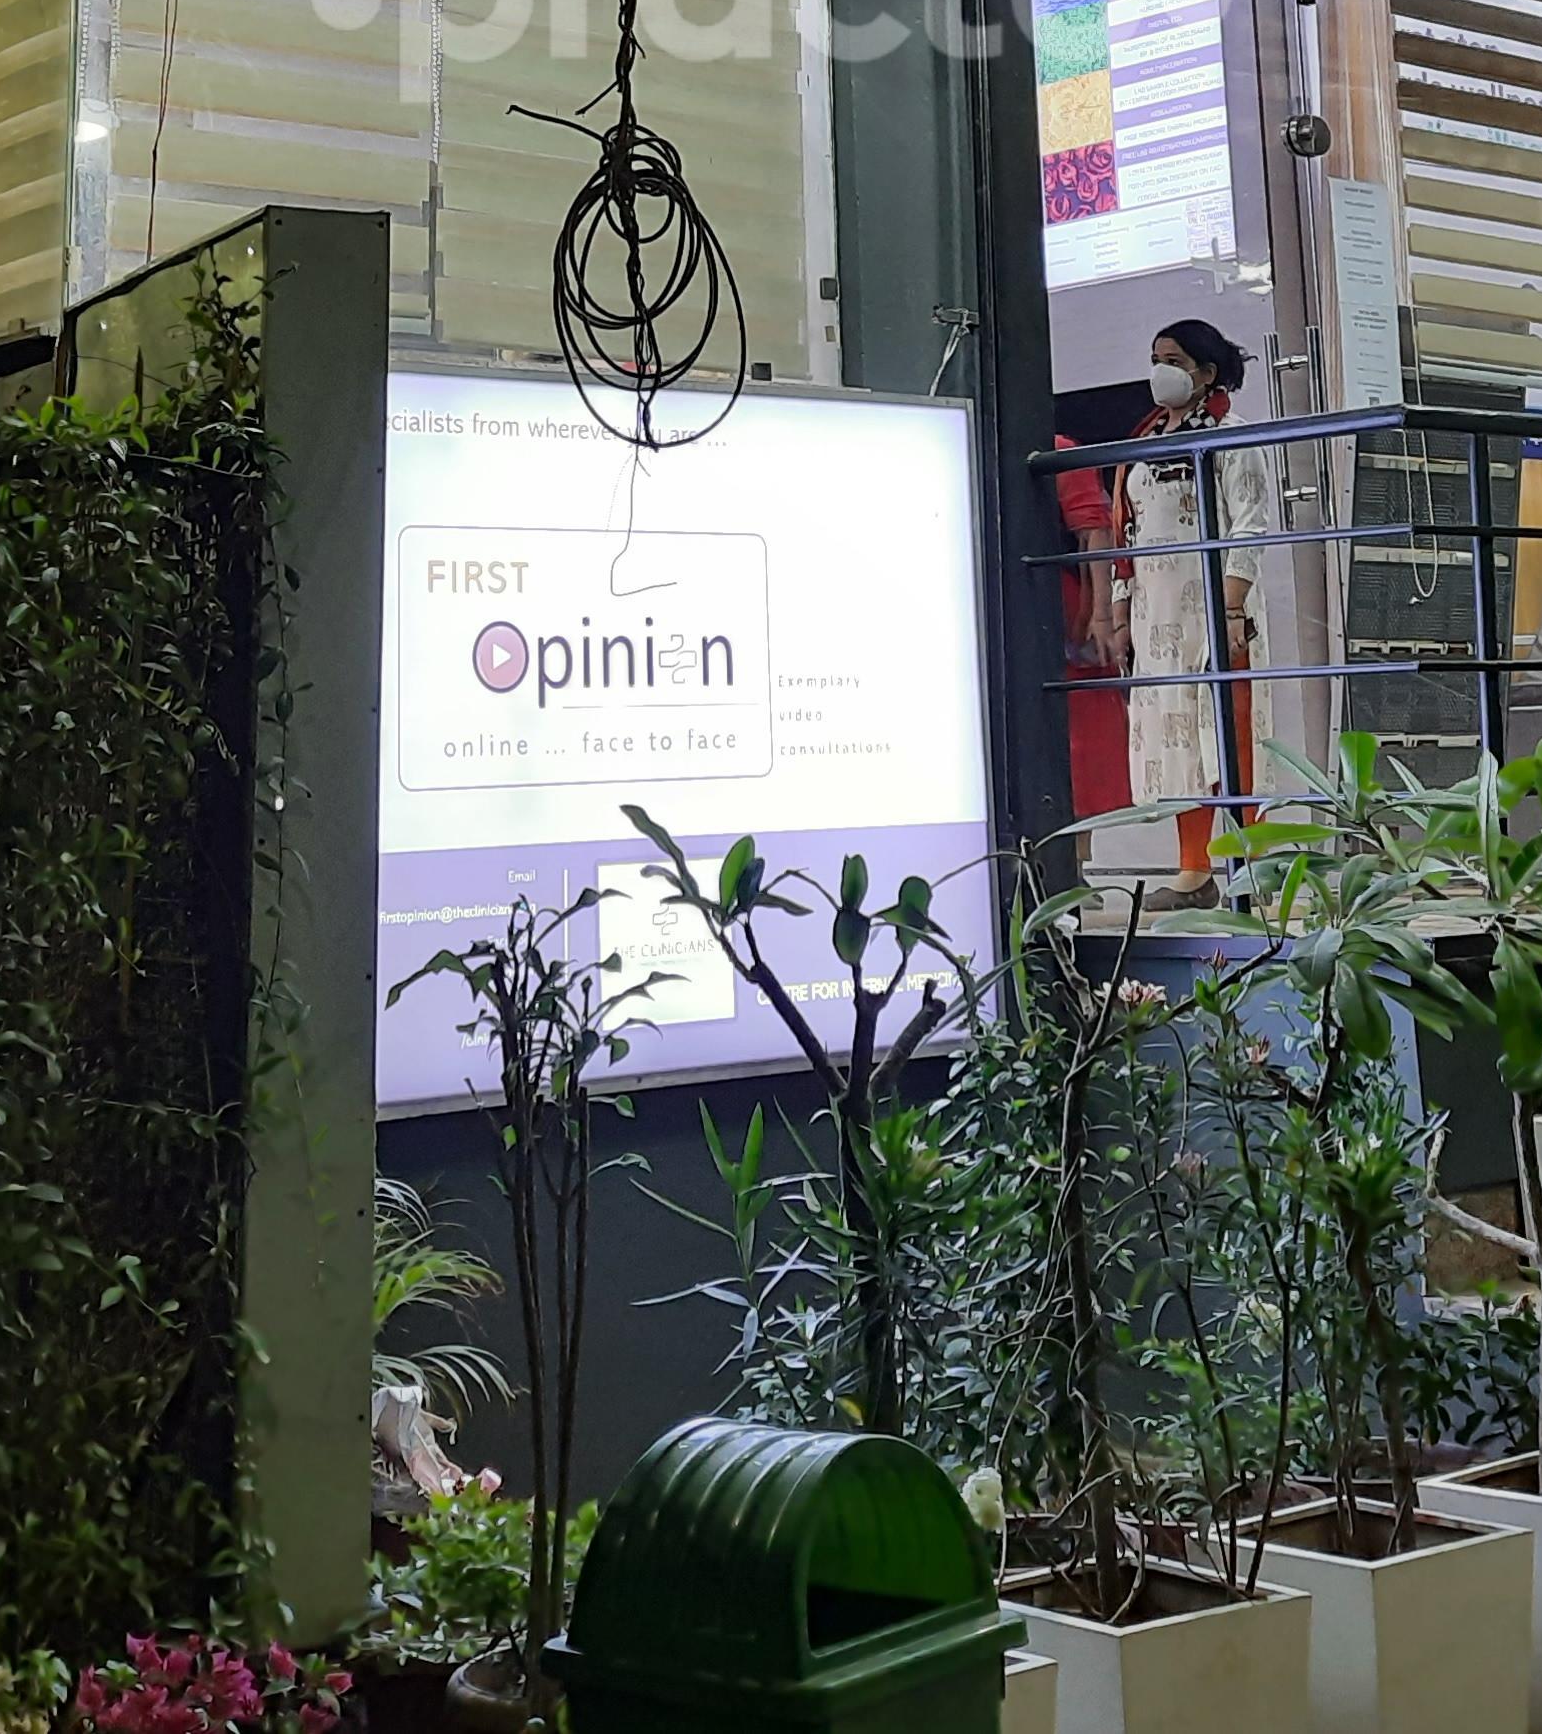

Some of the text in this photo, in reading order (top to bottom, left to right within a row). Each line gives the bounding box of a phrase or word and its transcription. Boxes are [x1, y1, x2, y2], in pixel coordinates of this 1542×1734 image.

[472, 412, 520, 437] from
[428, 561, 529, 594] FIRST
[443, 734, 529, 757] online
[582, 731, 633, 753] face
[649, 731, 672, 751] to
[688, 729, 736, 751] face
[508, 869, 536, 883] Email
[812, 981, 839, 1001] FOR
